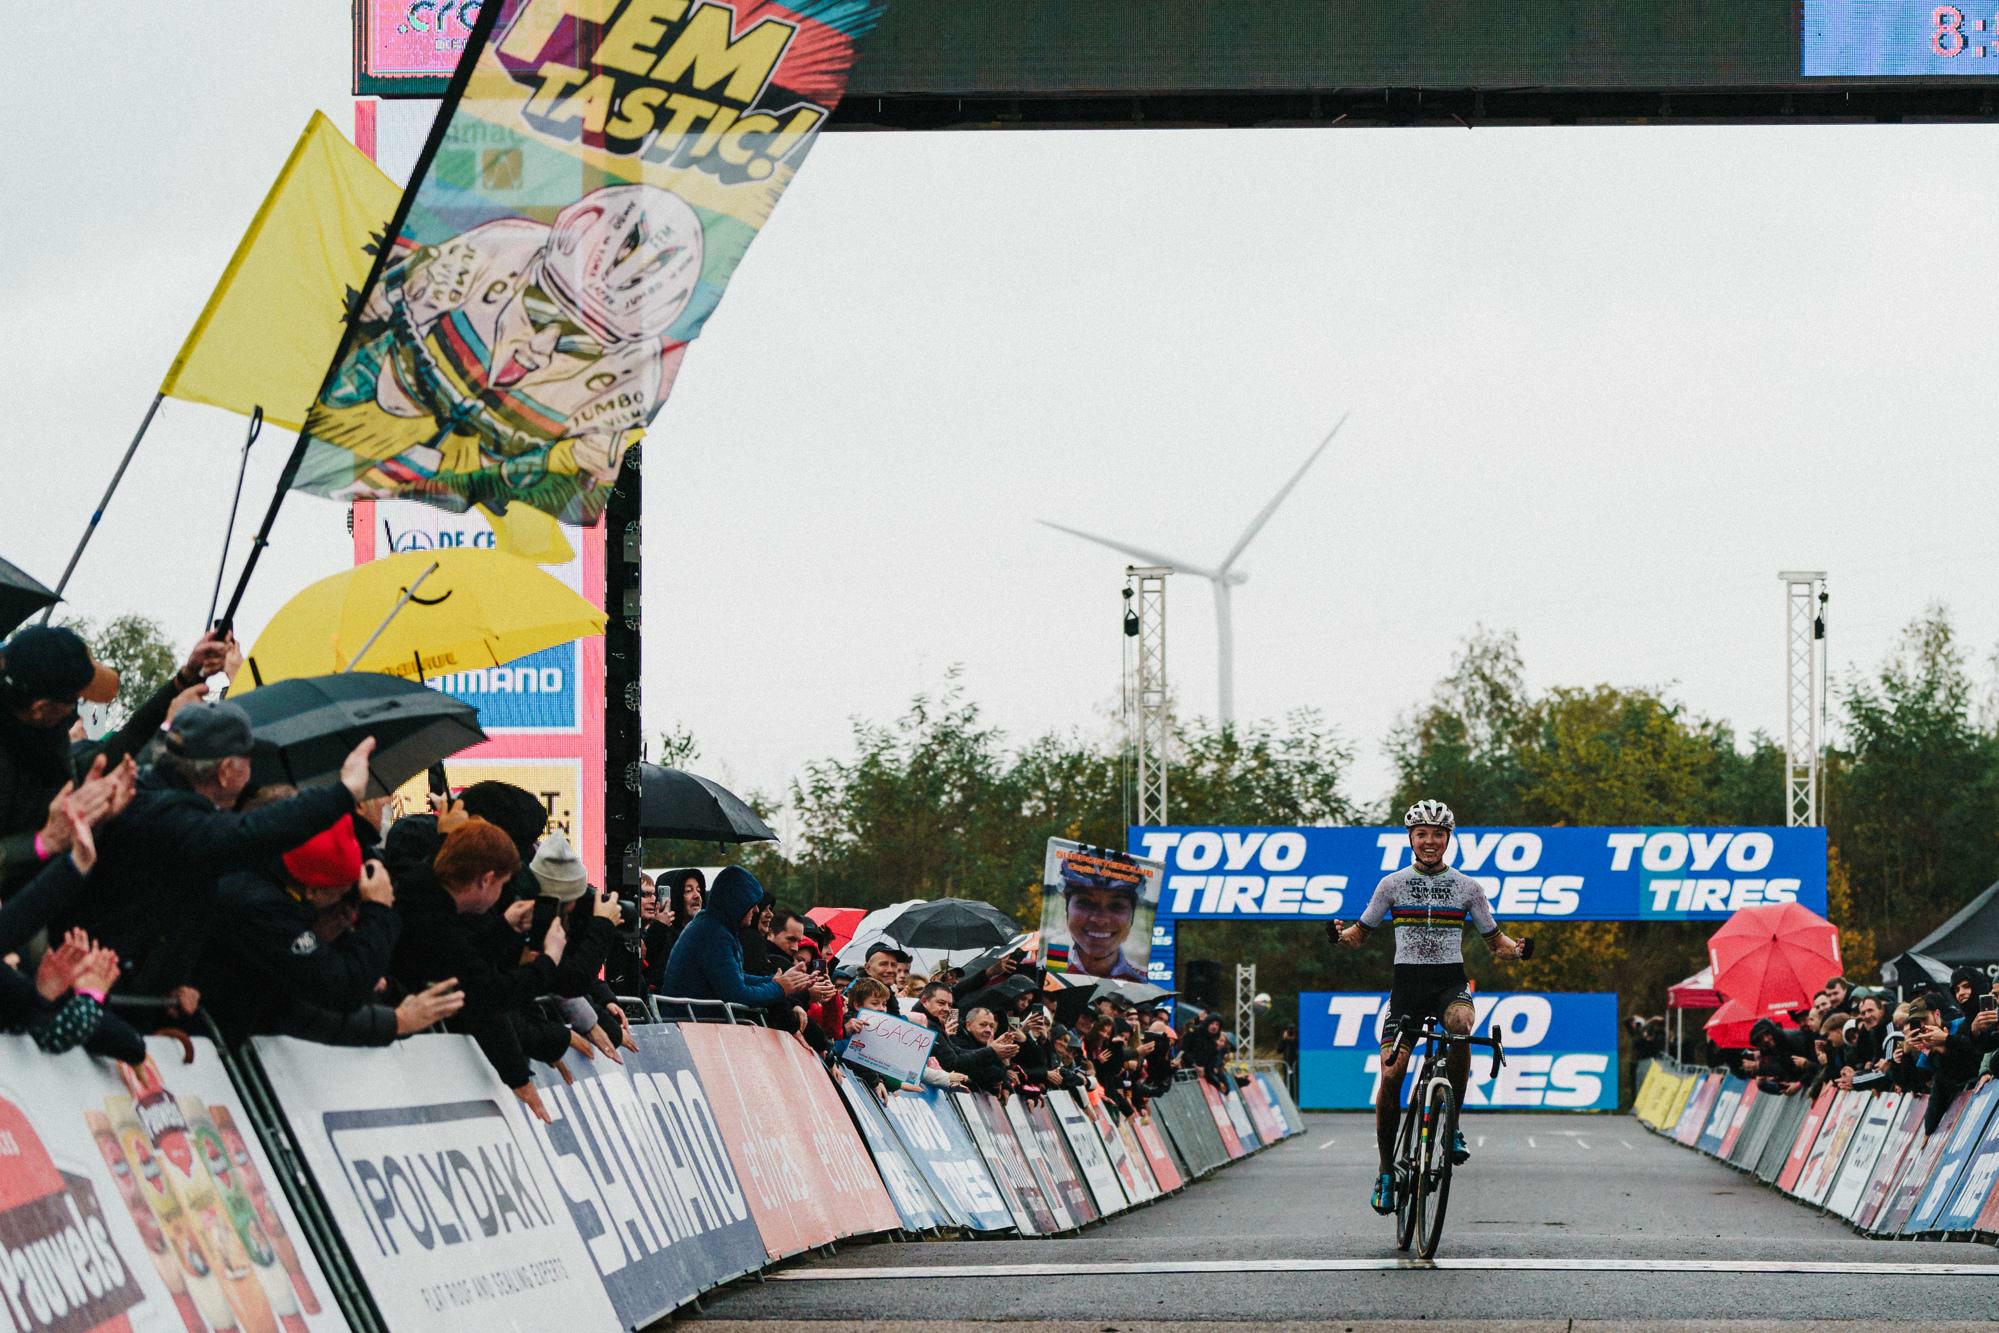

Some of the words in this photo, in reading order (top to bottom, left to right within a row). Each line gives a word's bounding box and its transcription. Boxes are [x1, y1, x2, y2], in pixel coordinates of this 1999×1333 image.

[1931, 6, 1999, 57] 8:
[525, 61, 821, 180] TASTIC!
[573, 390, 644, 426] JUMBO
[424, 667, 563, 693] IMANO
[1141, 832, 1307, 871] TOYO
[1606, 832, 1774, 872] TOYO
[1168, 875, 1348, 914] TIRES
[1470, 875, 1585, 915] RES
[1648, 878, 1801, 912] TIRES
[1328, 995, 1553, 1049] TO
[525, 1069, 748, 1276] SHIMANO
[353, 1142, 548, 1255] POLYDAK
